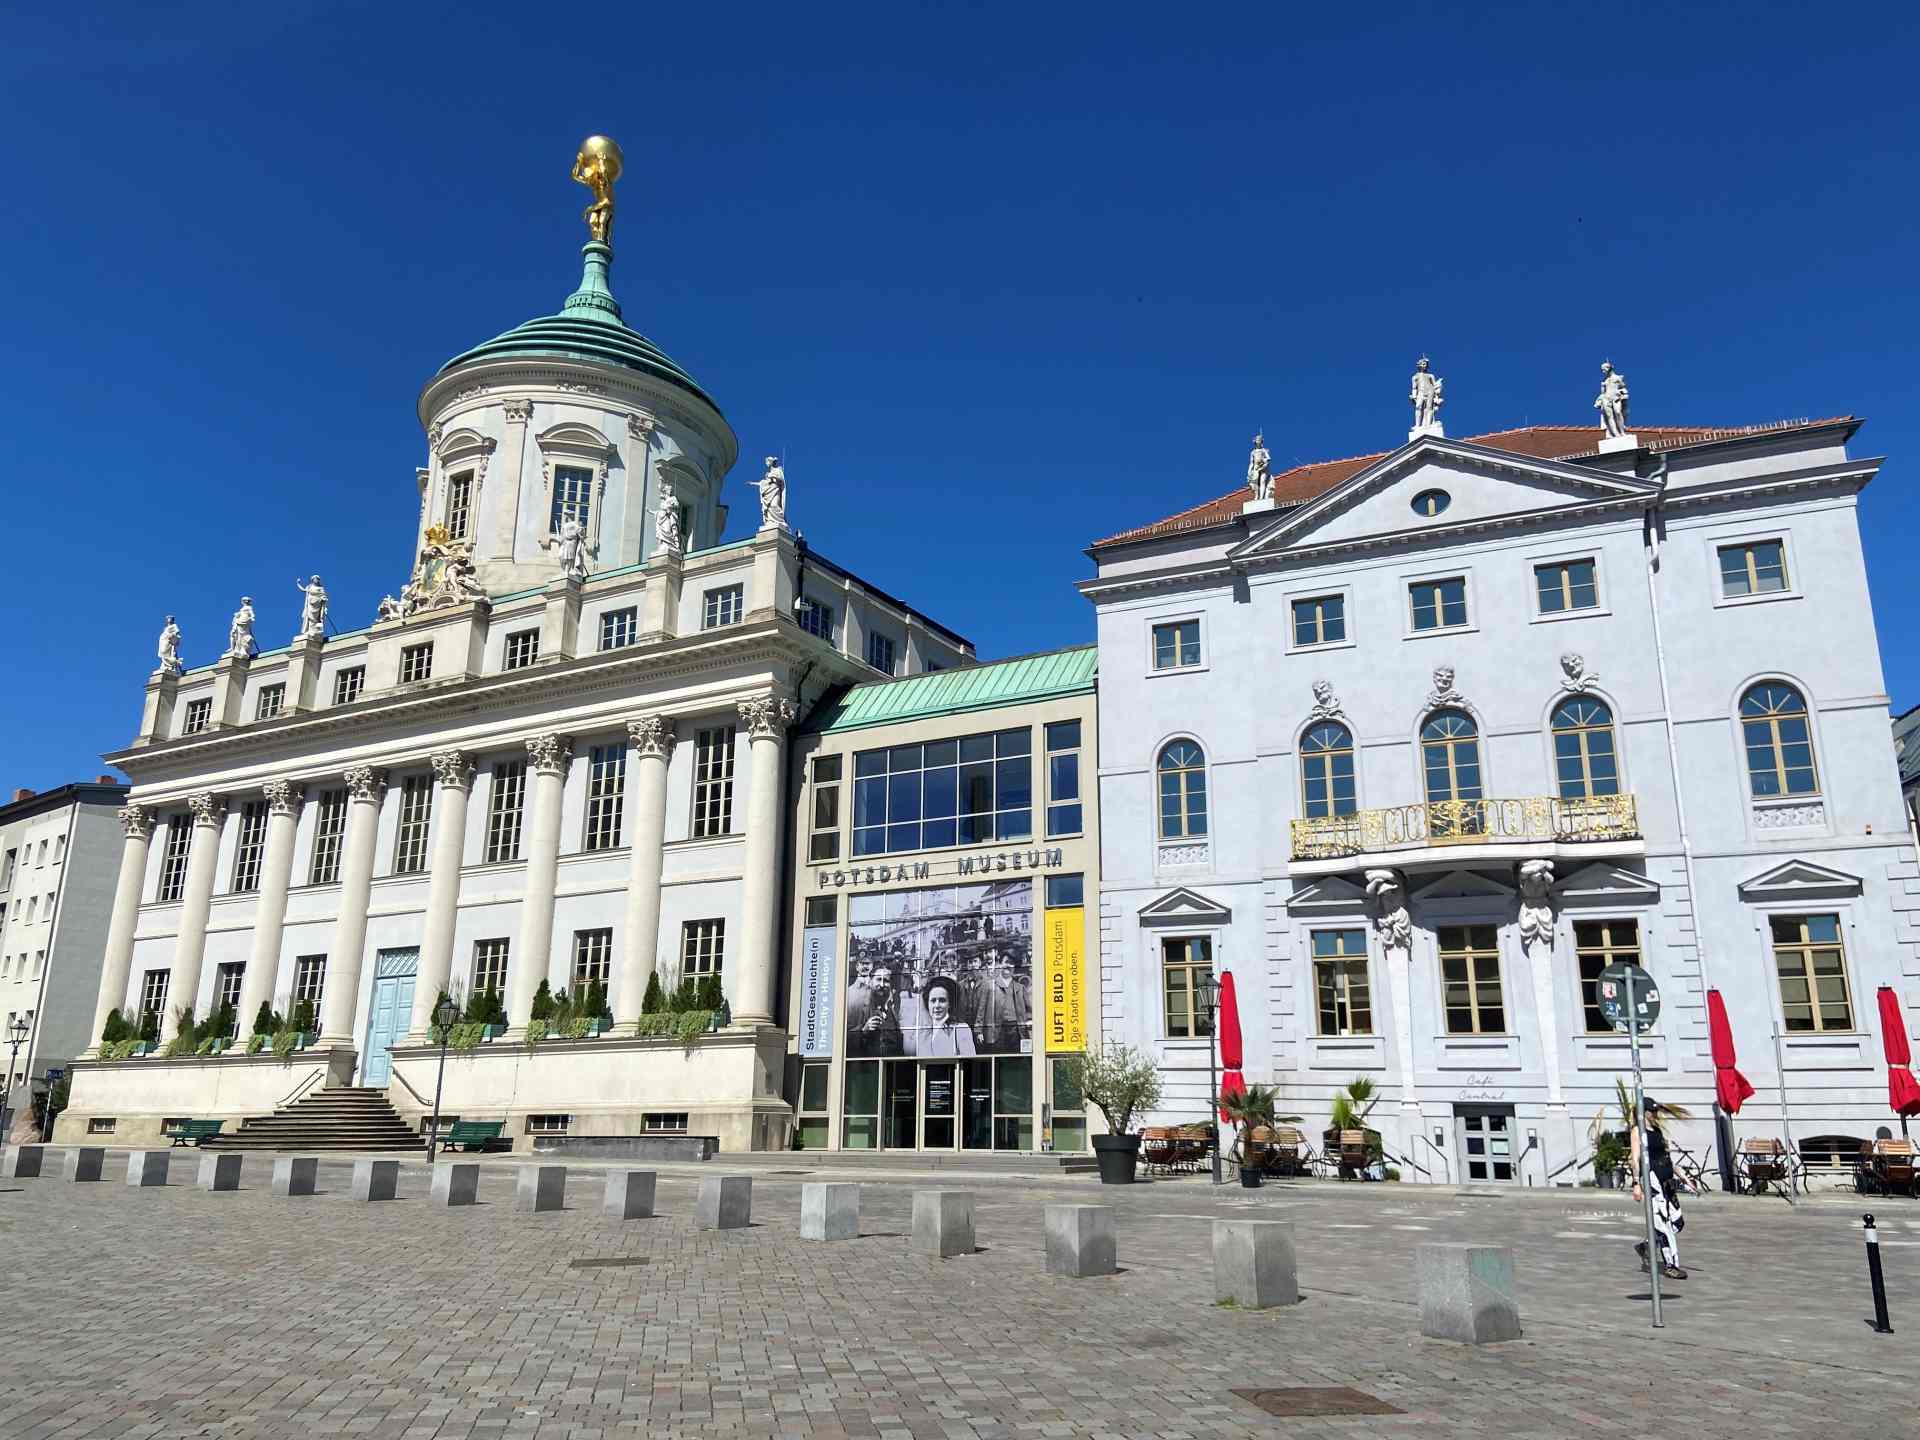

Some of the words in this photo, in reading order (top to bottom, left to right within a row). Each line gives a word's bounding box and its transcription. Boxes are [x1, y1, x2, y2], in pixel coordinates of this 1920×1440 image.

[819, 862, 929, 889] POTSDAM
[958, 848, 1063, 876] MUSEUM
[1052, 921, 1064, 967] Potsdam
[821, 956, 832, 993] History
[1053, 973, 1064, 1003] BILD
[1071, 979, 1079, 997] von
[806, 937, 819, 1051] StadtGeschichte(n)
[1053, 1011, 1064, 1043] LUFT
[1070, 999, 1079, 1025] Stadt
[819, 1030, 828, 1049] The
[1070, 1027, 1079, 1043] Die
[1458, 1089, 1505, 1100] Central
